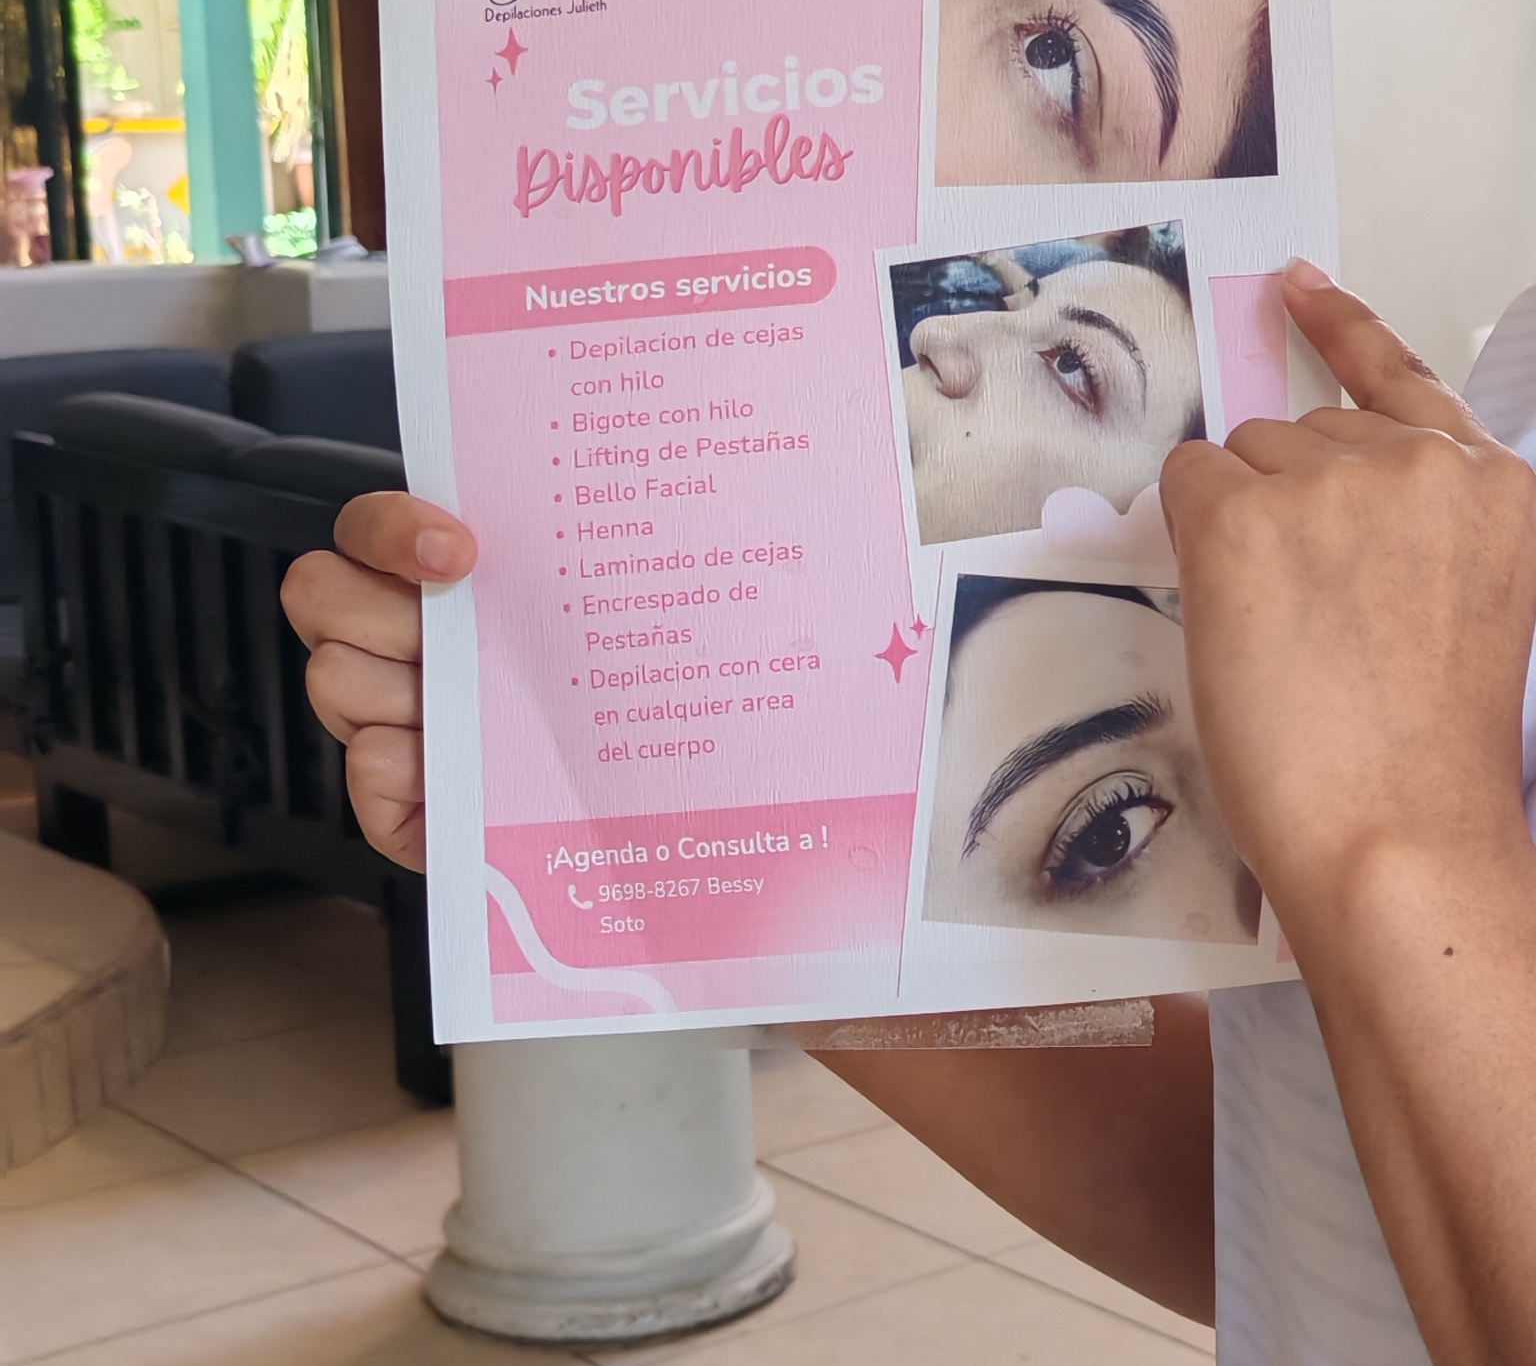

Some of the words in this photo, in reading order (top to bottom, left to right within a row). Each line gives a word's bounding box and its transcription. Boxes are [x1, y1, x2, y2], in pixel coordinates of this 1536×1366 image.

[484, 5, 563, 23] Depilaciones
[566, 55, 885, 131] Servicios
[513, 113, 854, 218] Disponibles
[525, 280, 666, 311] Nuestros
[675, 262, 812, 297] servicios
[570, 333, 697, 361] Depilacion
[705, 328, 736, 348] de
[743, 323, 804, 348] cejas
[570, 377, 613, 397] con
[620, 371, 665, 393] hilo
[572, 410, 651, 434] Bigote
[659, 406, 701, 425] con
[709, 399, 754, 422] hilo
[573, 445, 650, 469] Lifting
[658, 441, 688, 461] de
[696, 431, 810, 458] Pestañas
[574, 483, 637, 506] Bello
[646, 474, 717, 500] Facial
[577, 520, 654, 542] Henna
[579, 550, 696, 578] Laminado
[704, 545, 734, 568] de
[741, 541, 804, 567] cejas
[582, 584, 721, 616] Encrespado
[728, 580, 759, 602] de
[586, 625, 693, 652] Pestañas
[589, 661, 711, 691] Depilacion
[718, 658, 761, 678] con
[768, 653, 821, 673] cera
[593, 708, 619, 726] en
[626, 695, 734, 723] cualquier
[741, 693, 795, 714] area
[597, 741, 633, 763] del
[637, 737, 716, 761] cuerpo
[546, 840, 649, 876] ¡Agenda
[655, 844, 671, 863] o
[677, 830, 791, 861] Consulta
[798, 833, 814, 851] a
[821, 824, 830, 850] !
[598, 878, 701, 904] 9698-8267
[707, 876, 765, 897] Bessy
[600, 915, 646, 935] Soto
